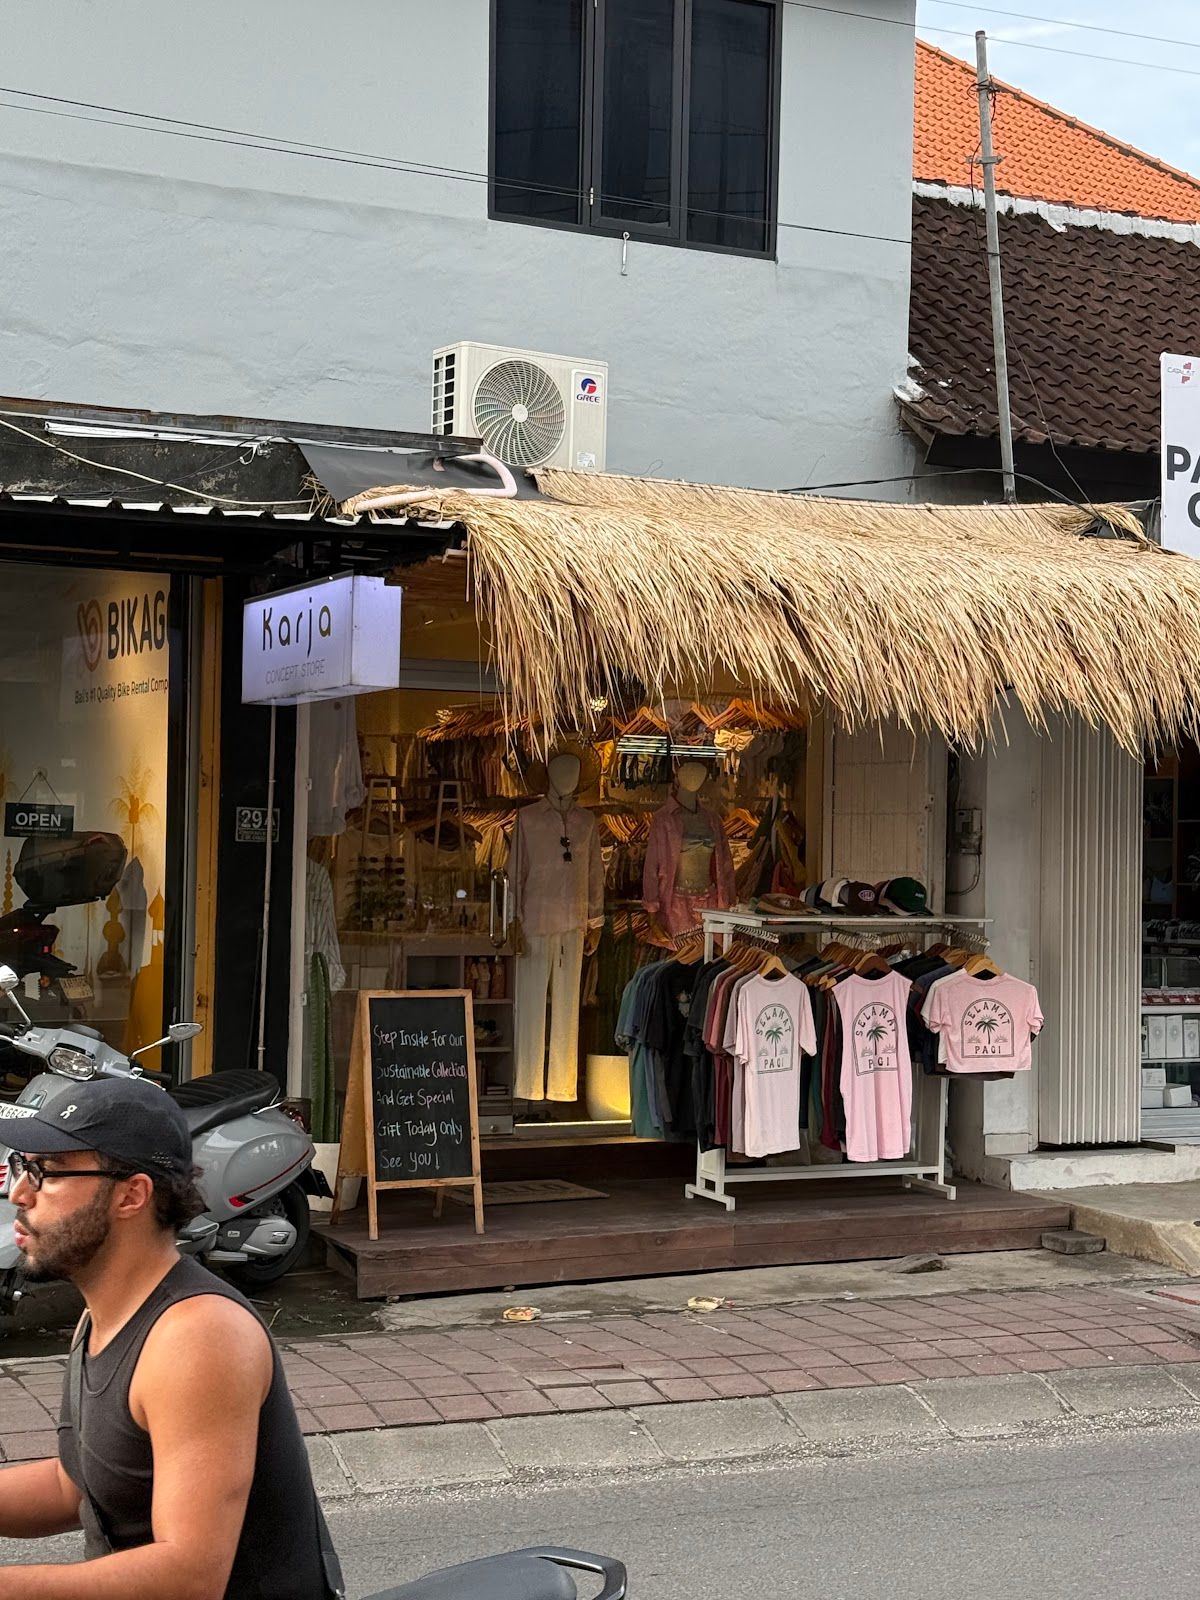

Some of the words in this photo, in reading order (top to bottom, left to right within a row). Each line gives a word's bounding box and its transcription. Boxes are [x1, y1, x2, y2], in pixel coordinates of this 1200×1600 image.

[576, 394, 601, 404] GREE
[107, 590, 170, 660] BIKAG
[262, 596, 331, 658] Karja
[265, 664, 299, 685] CONCEPT
[300, 659, 325, 678] STORE
[97, 684, 117, 703] Quality
[117, 682, 130, 698] Bike
[131, 677, 150, 696] Rental
[15, 812, 61, 827] OPEN
[756, 1008, 791, 1035] SELAMAT
[965, 1001, 1010, 1026] SELAMAT
[373, 1024, 398, 1050] Step
[400, 1029, 429, 1048] Inside
[431, 1030, 446, 1047] For
[974, 1045, 1001, 1054] PAGI
[764, 1058, 784, 1070] PAGI
[396, 1089, 415, 1107] Get
[417, 1088, 455, 1109] Special
[404, 1120, 438, 1147] Today
[440, 1118, 463, 1145] Only
[381, 1149, 402, 1169] See
